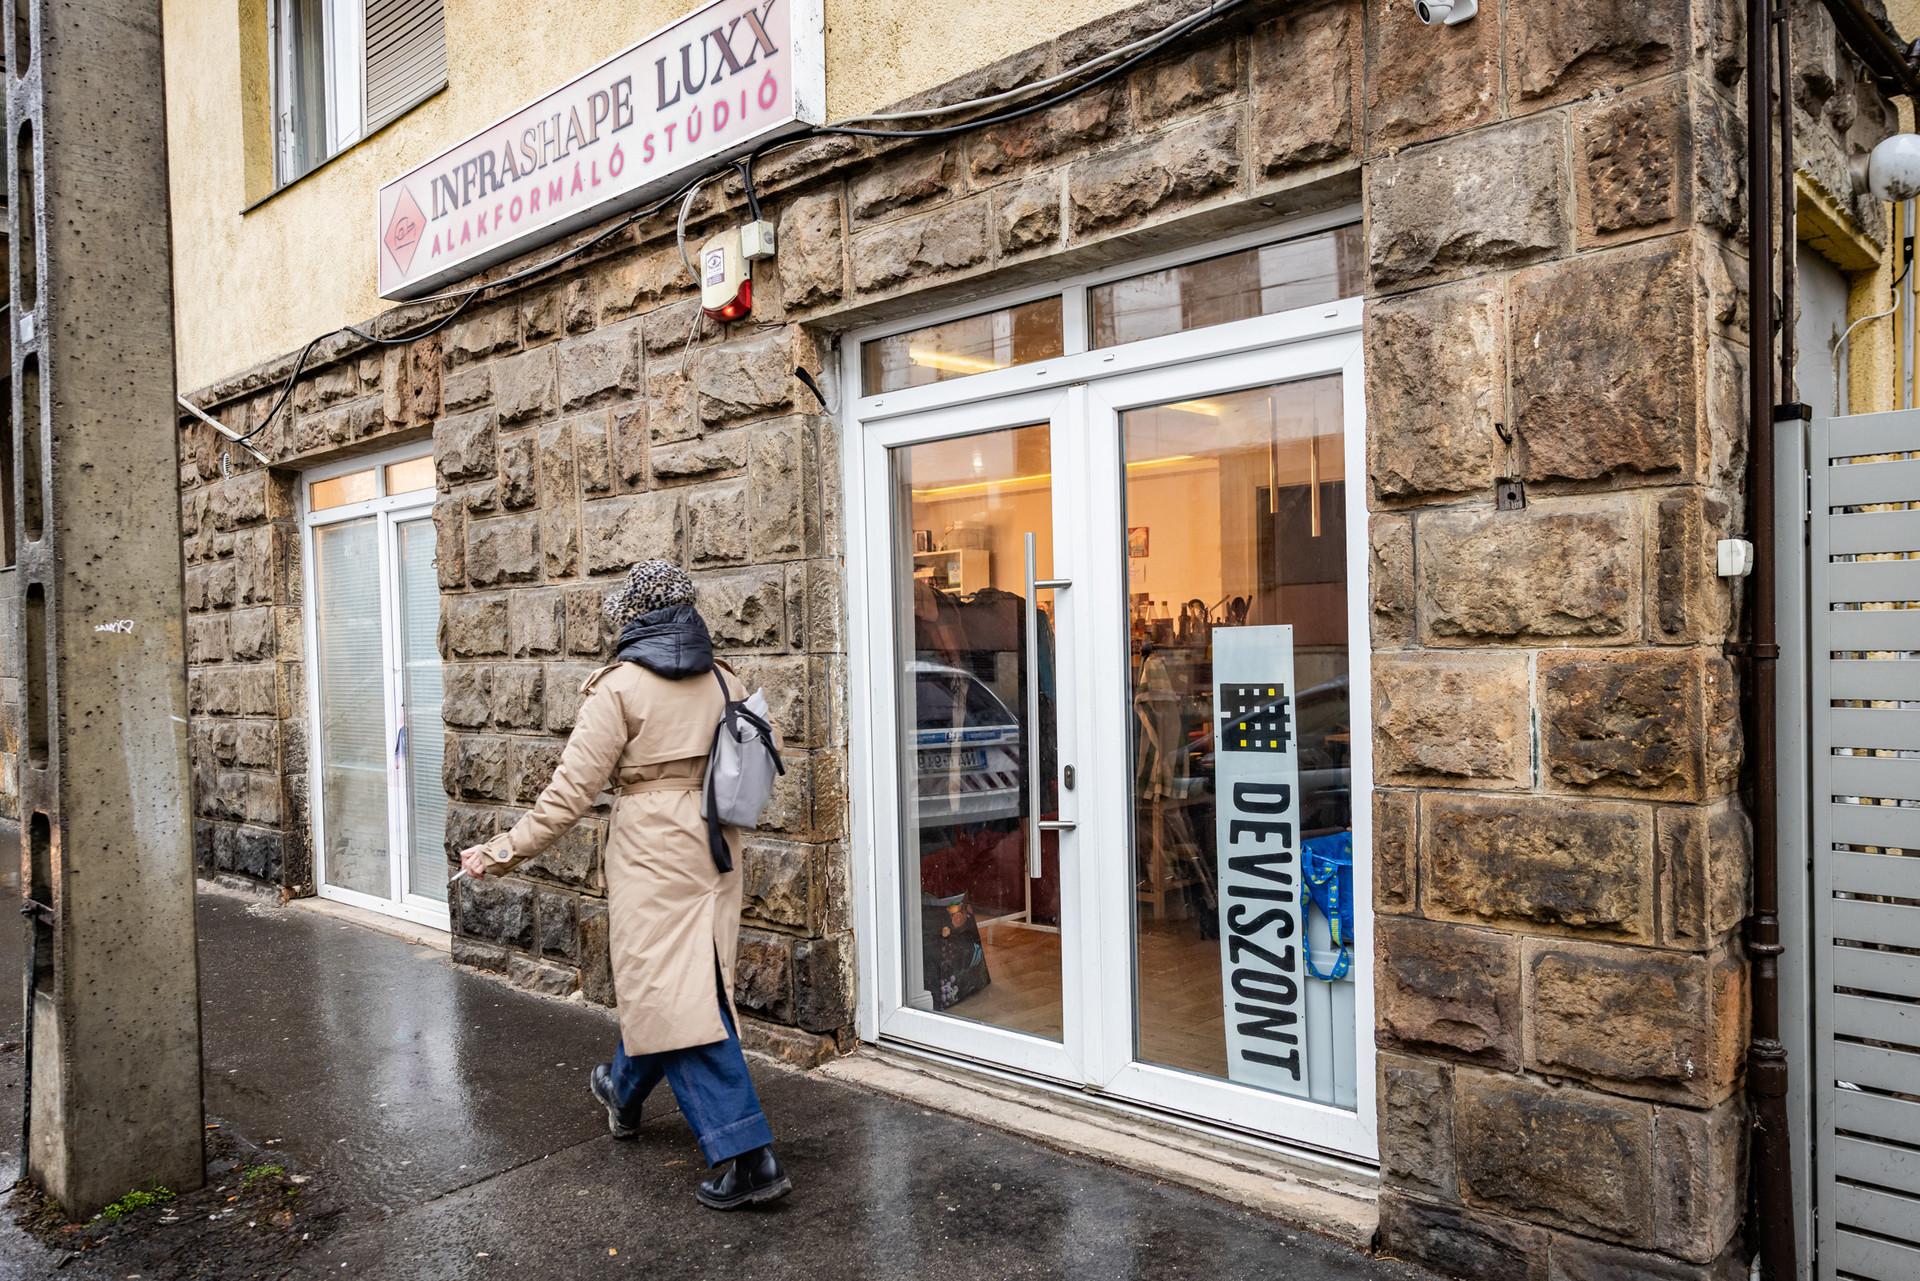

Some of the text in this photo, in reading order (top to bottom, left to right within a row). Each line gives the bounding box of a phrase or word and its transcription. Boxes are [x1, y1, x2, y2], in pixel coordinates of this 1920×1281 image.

[431, 0, 779, 222] INFRASHAPE LUXX
[431, 69, 778, 259] ALAKFORMÁLÓ STÚDIÓ
[1227, 781, 1301, 1082] DEVISZONT
